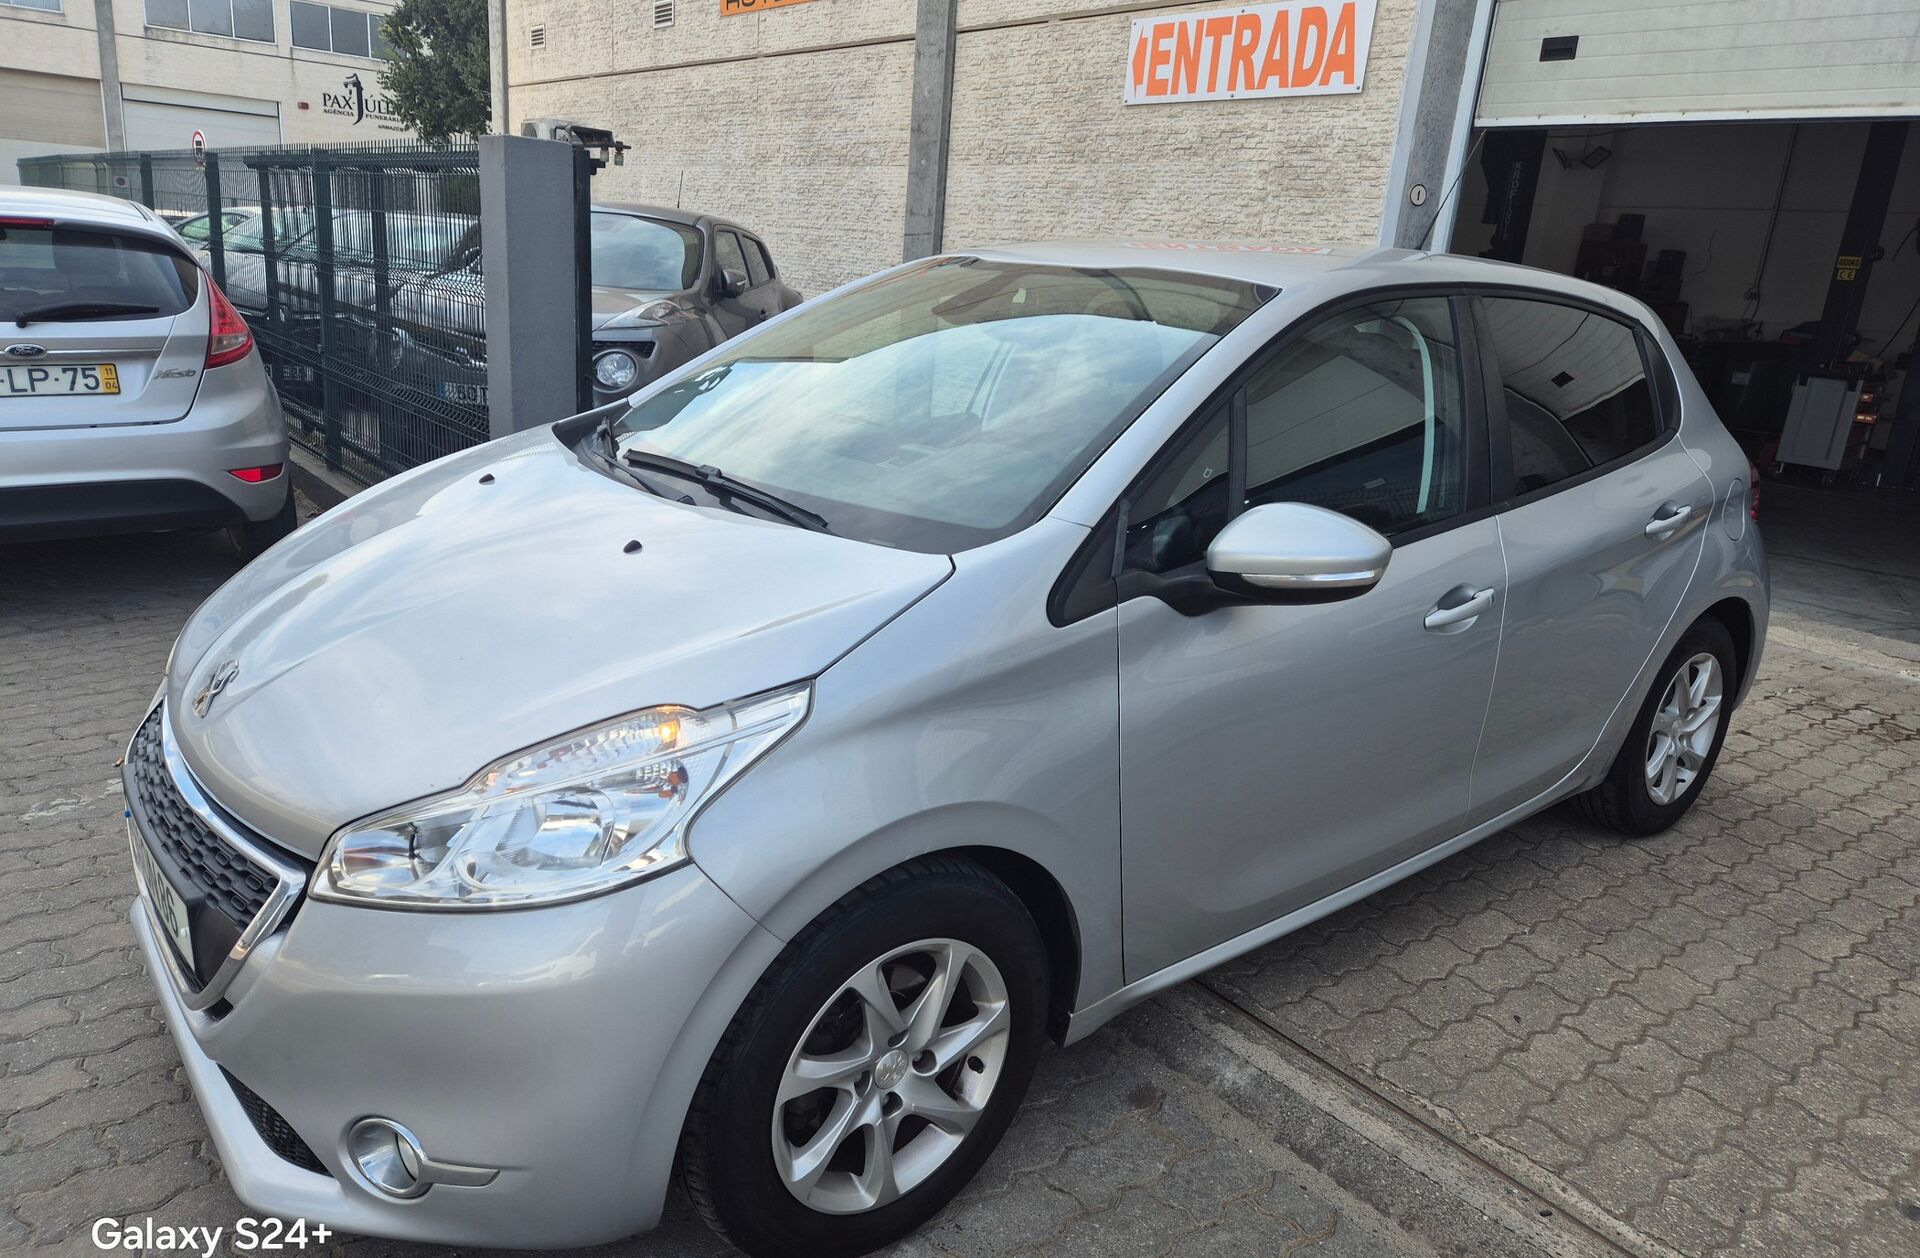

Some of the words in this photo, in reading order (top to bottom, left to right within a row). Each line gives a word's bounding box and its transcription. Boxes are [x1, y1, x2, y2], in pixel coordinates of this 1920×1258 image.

[1146, 2, 1356, 97] ENTRADA
[14, 345, 38, 355] Ford
[104, 367, 113, 377] 11
[105, 381, 118, 390] 04
